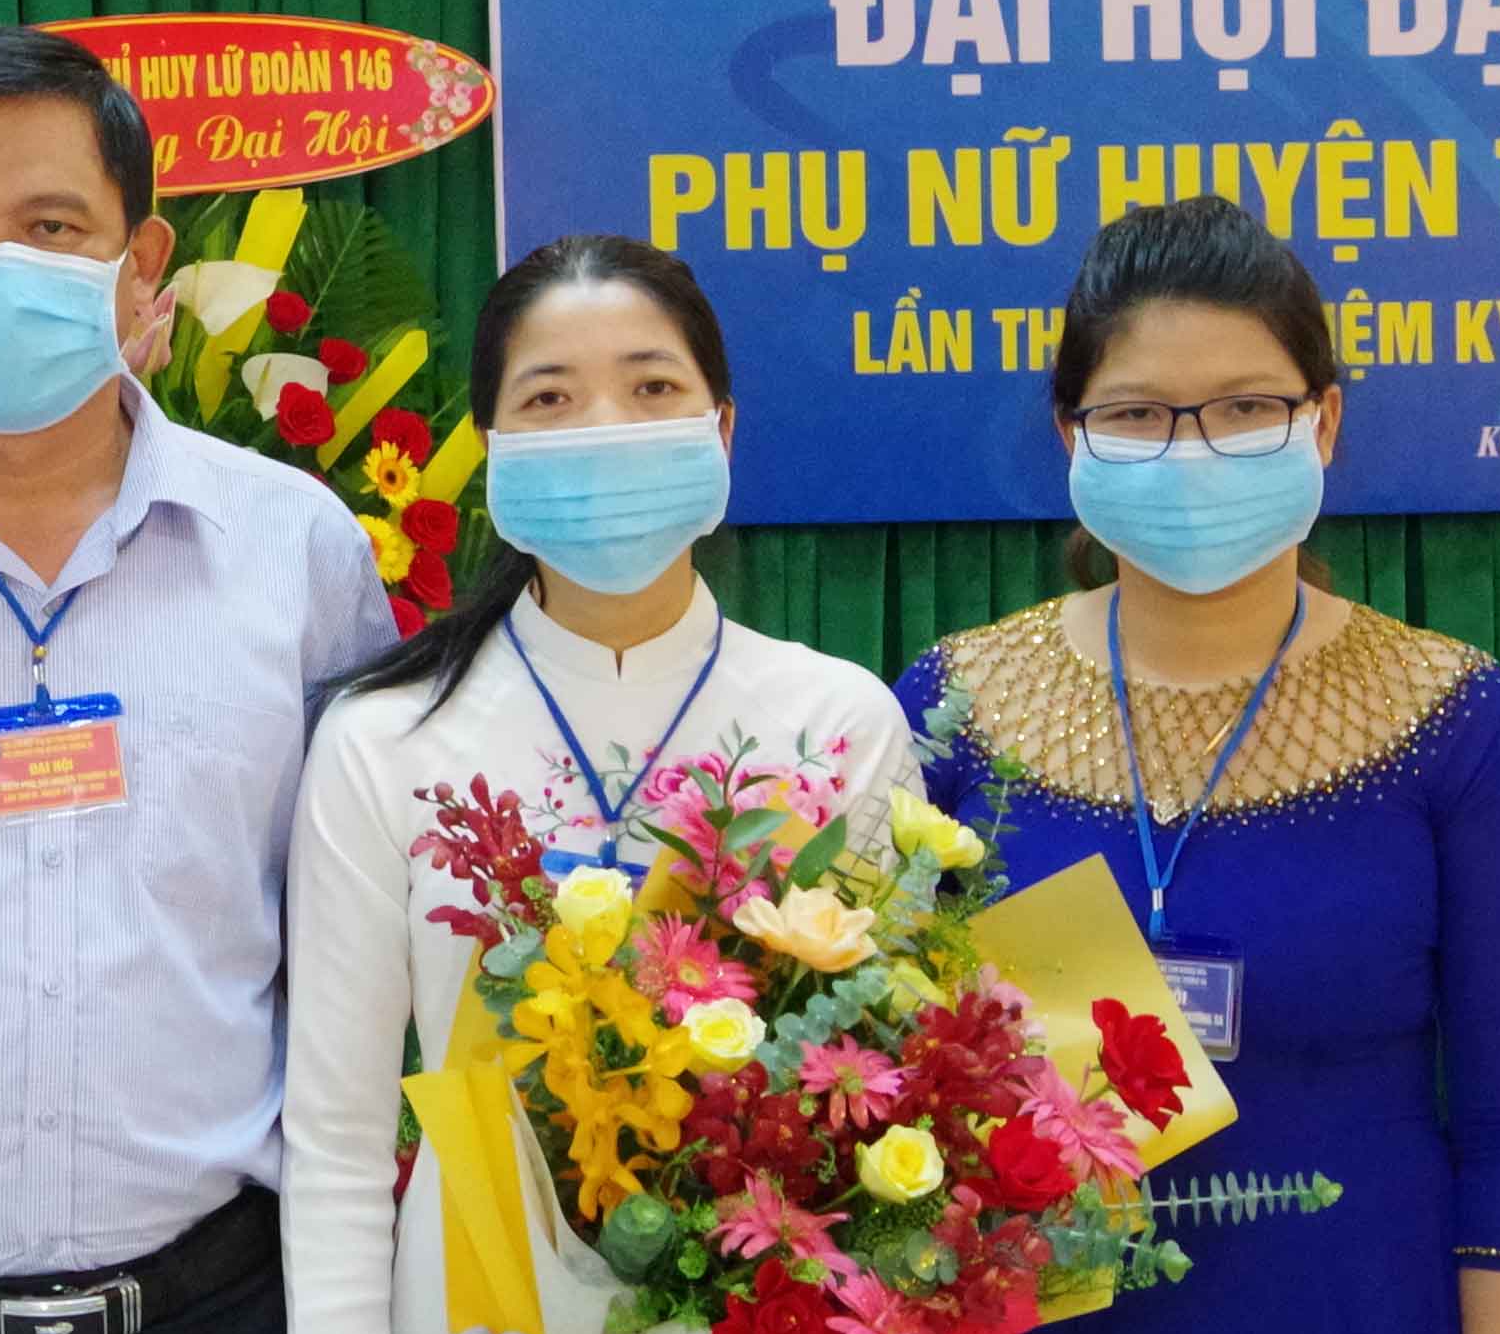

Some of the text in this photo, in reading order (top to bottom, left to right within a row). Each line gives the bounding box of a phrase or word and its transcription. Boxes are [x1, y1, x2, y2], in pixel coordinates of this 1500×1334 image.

[140, 54, 197, 99] HUY
[206, 44, 244, 98] LỮ
[250, 41, 331, 95] ĐOÀN
[339, 48, 393, 91] 146
[197, 114, 287, 168] Đại
[303, 110, 392, 164] Hội
[648, 151, 866, 272] PHỤ
[907, 125, 1070, 250] NỮ
[1098, 118, 1458, 263] HUYỆN
[853, 287, 972, 374] LẦN
